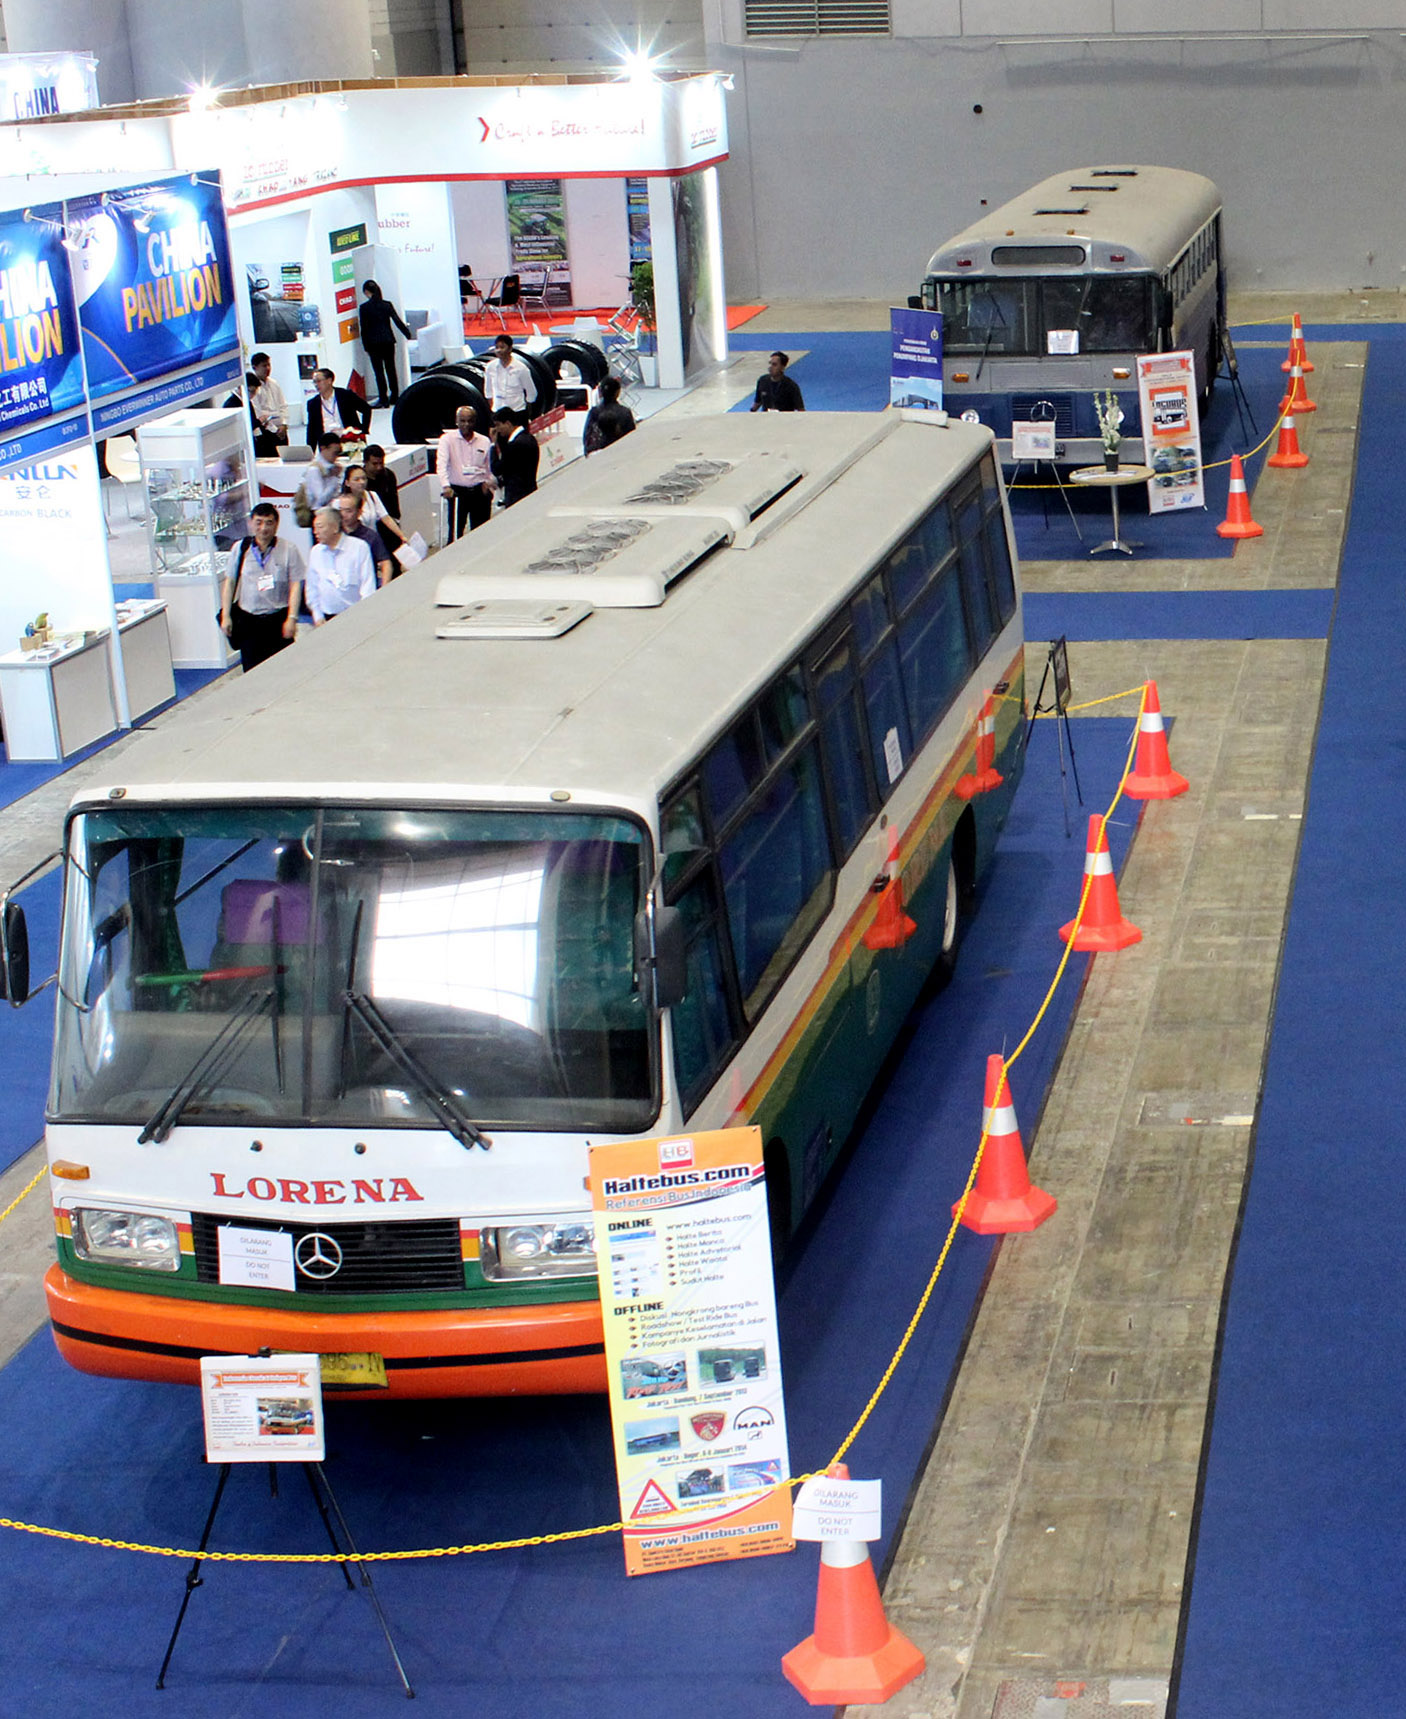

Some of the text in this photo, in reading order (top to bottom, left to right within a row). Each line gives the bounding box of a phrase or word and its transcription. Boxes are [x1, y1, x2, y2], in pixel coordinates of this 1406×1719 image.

[14, 86, 61, 119] CHINA
[378, 219, 410, 229] ubber
[148, 220, 217, 278] CHINA
[0, 260, 59, 320] HINA
[121, 262, 223, 333] PAVILION
[0, 308, 64, 374] LION
[0, 376, 48, 408] 工有限公司
[37, 508, 72, 519] BLACK
[604, 1166, 750, 1195] Haltebus.com
[210, 1172, 424, 1205] LORENA
[605, 1183, 752, 1210] Referensi Bus Indonesia
[607, 1217, 653, 1232] ONLINE
[666, 1214, 752, 1230] www.haltebus.com
[245, 1261, 270, 1270] DO NOT
[248, 1272, 269, 1280] ENTER
[614, 1301, 664, 1316] OFFLINE
[737, 1419, 771, 1430] MAN
[813, 1488, 859, 1500] DILARANG
[819, 1499, 851, 1508] MASUK
[818, 1516, 853, 1526] DO NOT
[639, 1520, 779, 1549] www.haltebus.com
[820, 1527, 850, 1536] ENTER
